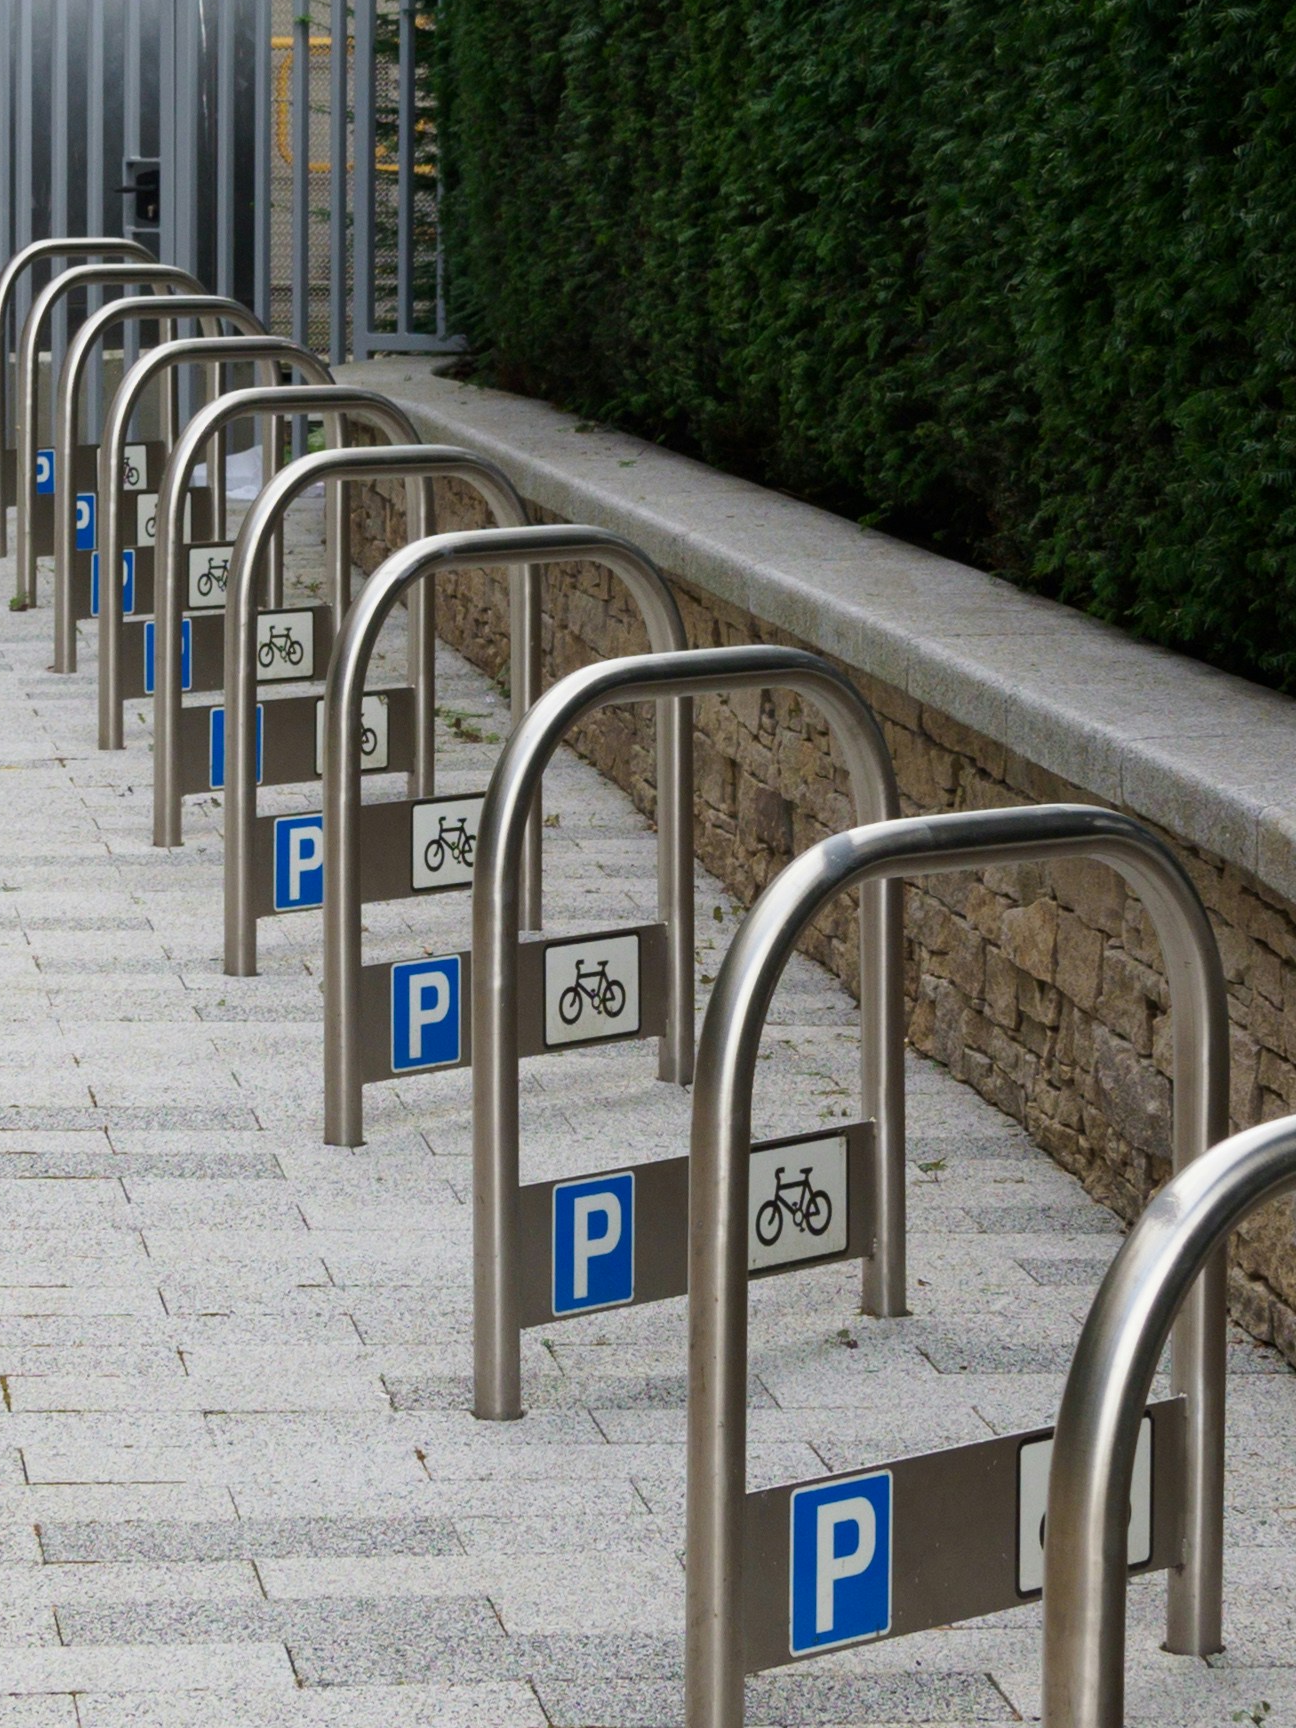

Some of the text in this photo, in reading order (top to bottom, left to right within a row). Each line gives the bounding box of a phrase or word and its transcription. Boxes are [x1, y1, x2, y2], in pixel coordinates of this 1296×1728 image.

[289, 826, 324, 901] P
[409, 971, 450, 1059] P
[574, 1192, 622, 1299] P
[816, 1497, 876, 1633] P
